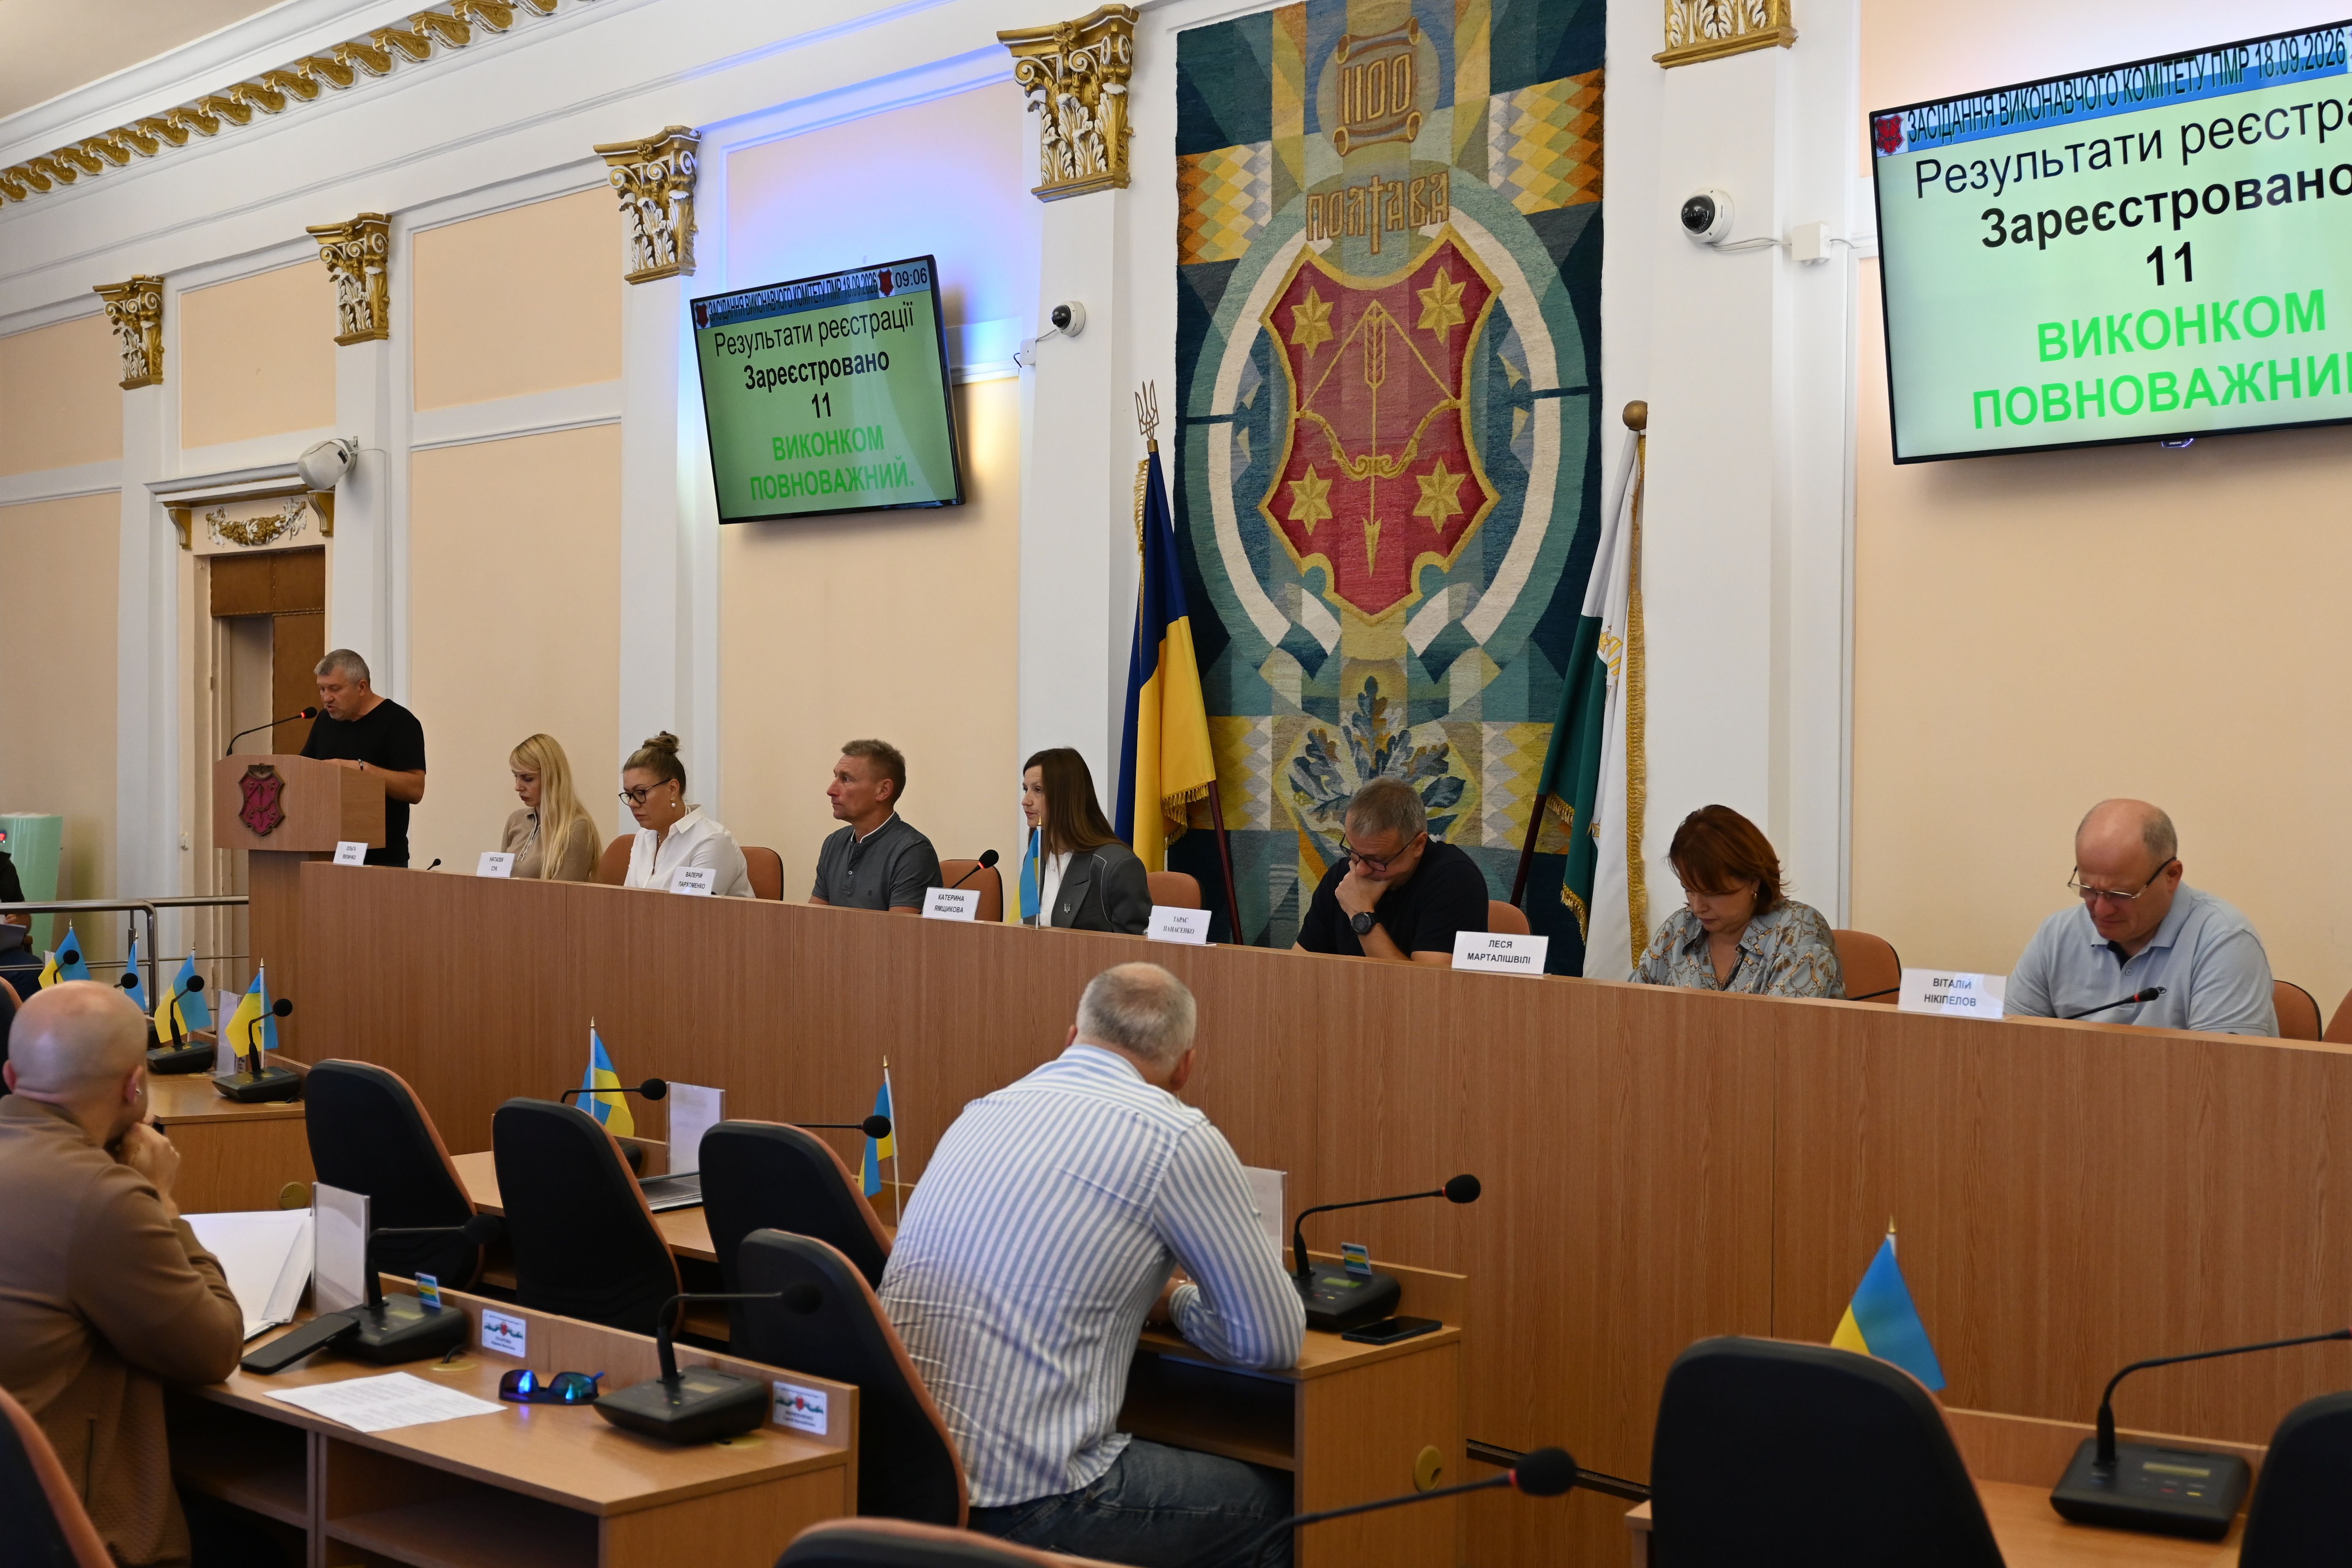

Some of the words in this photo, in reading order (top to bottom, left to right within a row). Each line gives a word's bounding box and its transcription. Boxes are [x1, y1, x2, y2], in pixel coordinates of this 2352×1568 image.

[1908, 95, 1995, 144] ЗАСІДАННЯ
[1998, 72, 2119, 126] ВИКОНАВЧОГО
[2123, 54, 2205, 104] КОМІТЕТУ
[2211, 46, 2249, 88] ПМР
[2255, 28, 2345, 79] 18.09.2026
[1916, 129, 2163, 199] Результати
[2181, 96, 2352, 165] реєстр
[1307, 170, 1450, 255] ПОЛТАВА
[1981, 163, 2352, 250] Зареєстровано
[895, 267, 927, 288] 09:06
[2146, 241, 2193, 286] 11
[709, 296, 745, 324] ЗАСІДАННЯ
[745, 287, 792, 316] ВИКОНАВЧОГО
[793, 280, 824, 306] КОМІТЕТУ
[827, 278, 841, 302] ПМР
[843, 272, 878, 299] 18.09.2026
[714, 323, 813, 359] Результати
[819, 301, 914, 347] реєстрації
[2037, 289, 2327, 362] ВИКОНКОМ
[744, 351, 889, 393] Зареєстровано
[1973, 351, 2352, 429] ПОВНОВАЖНИ
[811, 392, 831, 418] 11
[772, 425, 885, 461] ВИКОНКОМ
[750, 455, 915, 501] ПОВНОВАЖНИЙ.
[1163, 926, 1195, 934] ПАНАСЕНКО
[1488, 940, 1512, 948] ЛЕСЯ
[1467, 953, 1530, 964] МАРТАЛІШВІЛІ
[1924, 994, 1976, 1007] НІКІПЕЛОВ
[1933, 978, 1971, 990] ВІТАЛІЙ
